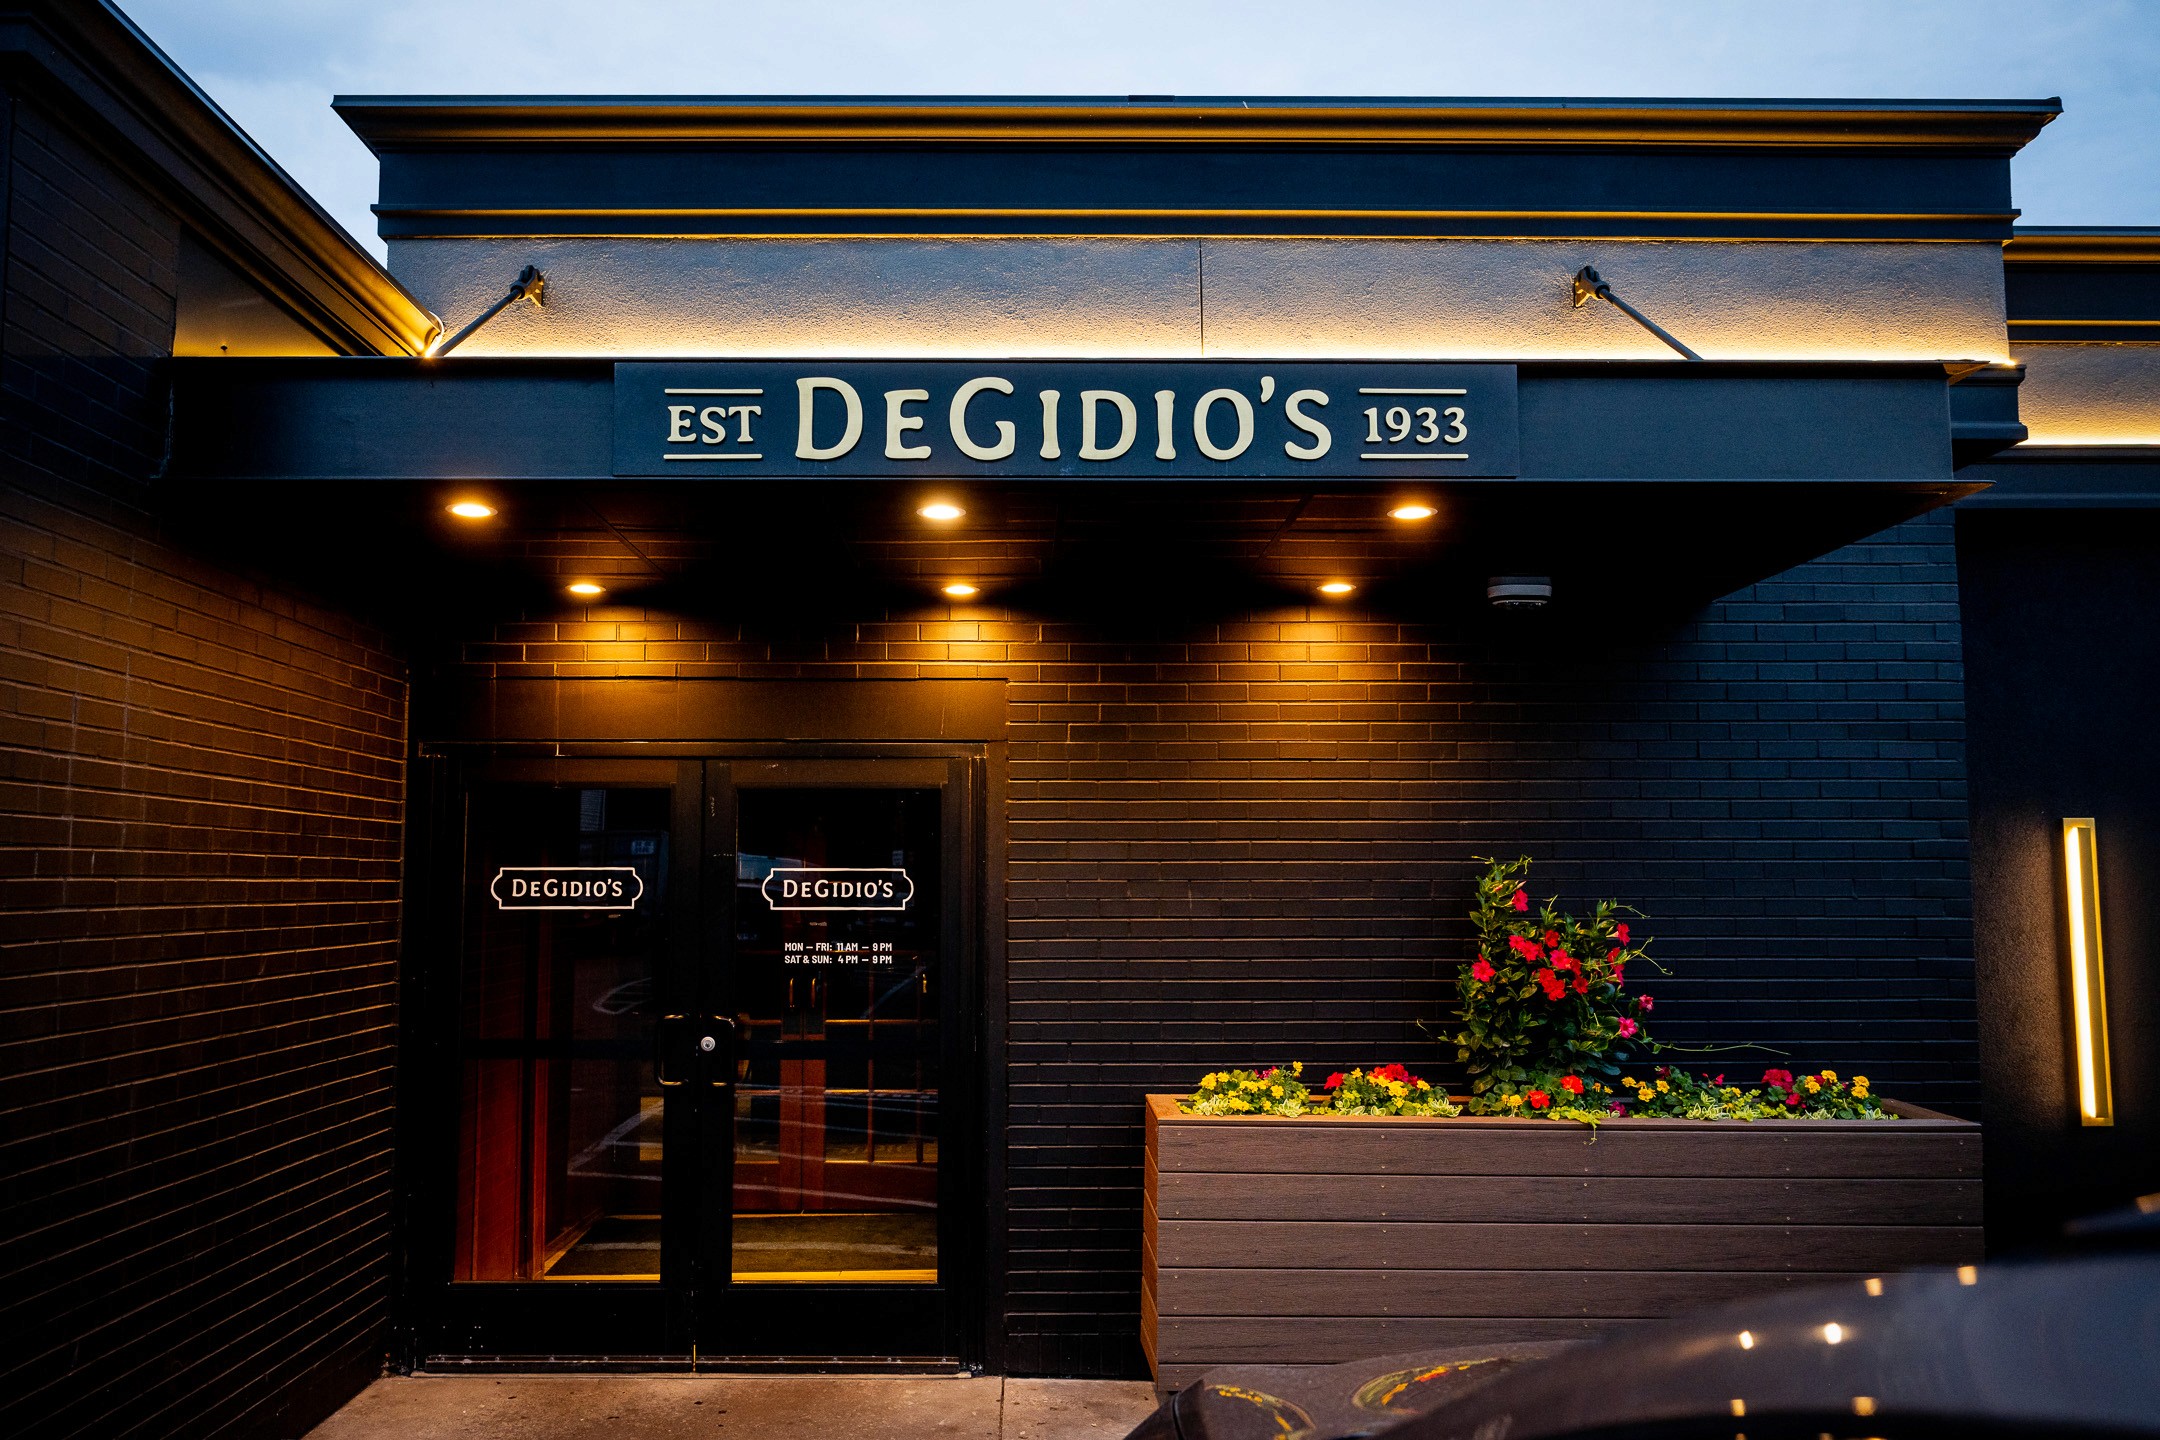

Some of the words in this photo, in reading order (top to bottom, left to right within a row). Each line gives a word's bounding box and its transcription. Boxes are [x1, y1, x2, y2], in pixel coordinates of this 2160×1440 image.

[667, 405, 762, 444] EST
[1363, 406, 1468, 443] 1933
[784, 942, 804, 951] MON
[815, 942, 833, 951] FRI:
[836, 942, 844, 951] 11
[845, 942, 858, 951] AM
[872, 942, 878, 951] 9
[879, 942, 893, 951] PM
[784, 955, 802, 964] SAT
[802, 955, 810, 964] &
[811, 955, 833, 964] SUN:
[837, 955, 844, 964] 4
[845, 955, 858, 964] PM
[872, 955, 878, 964] 9
[879, 955, 893, 964] PM
